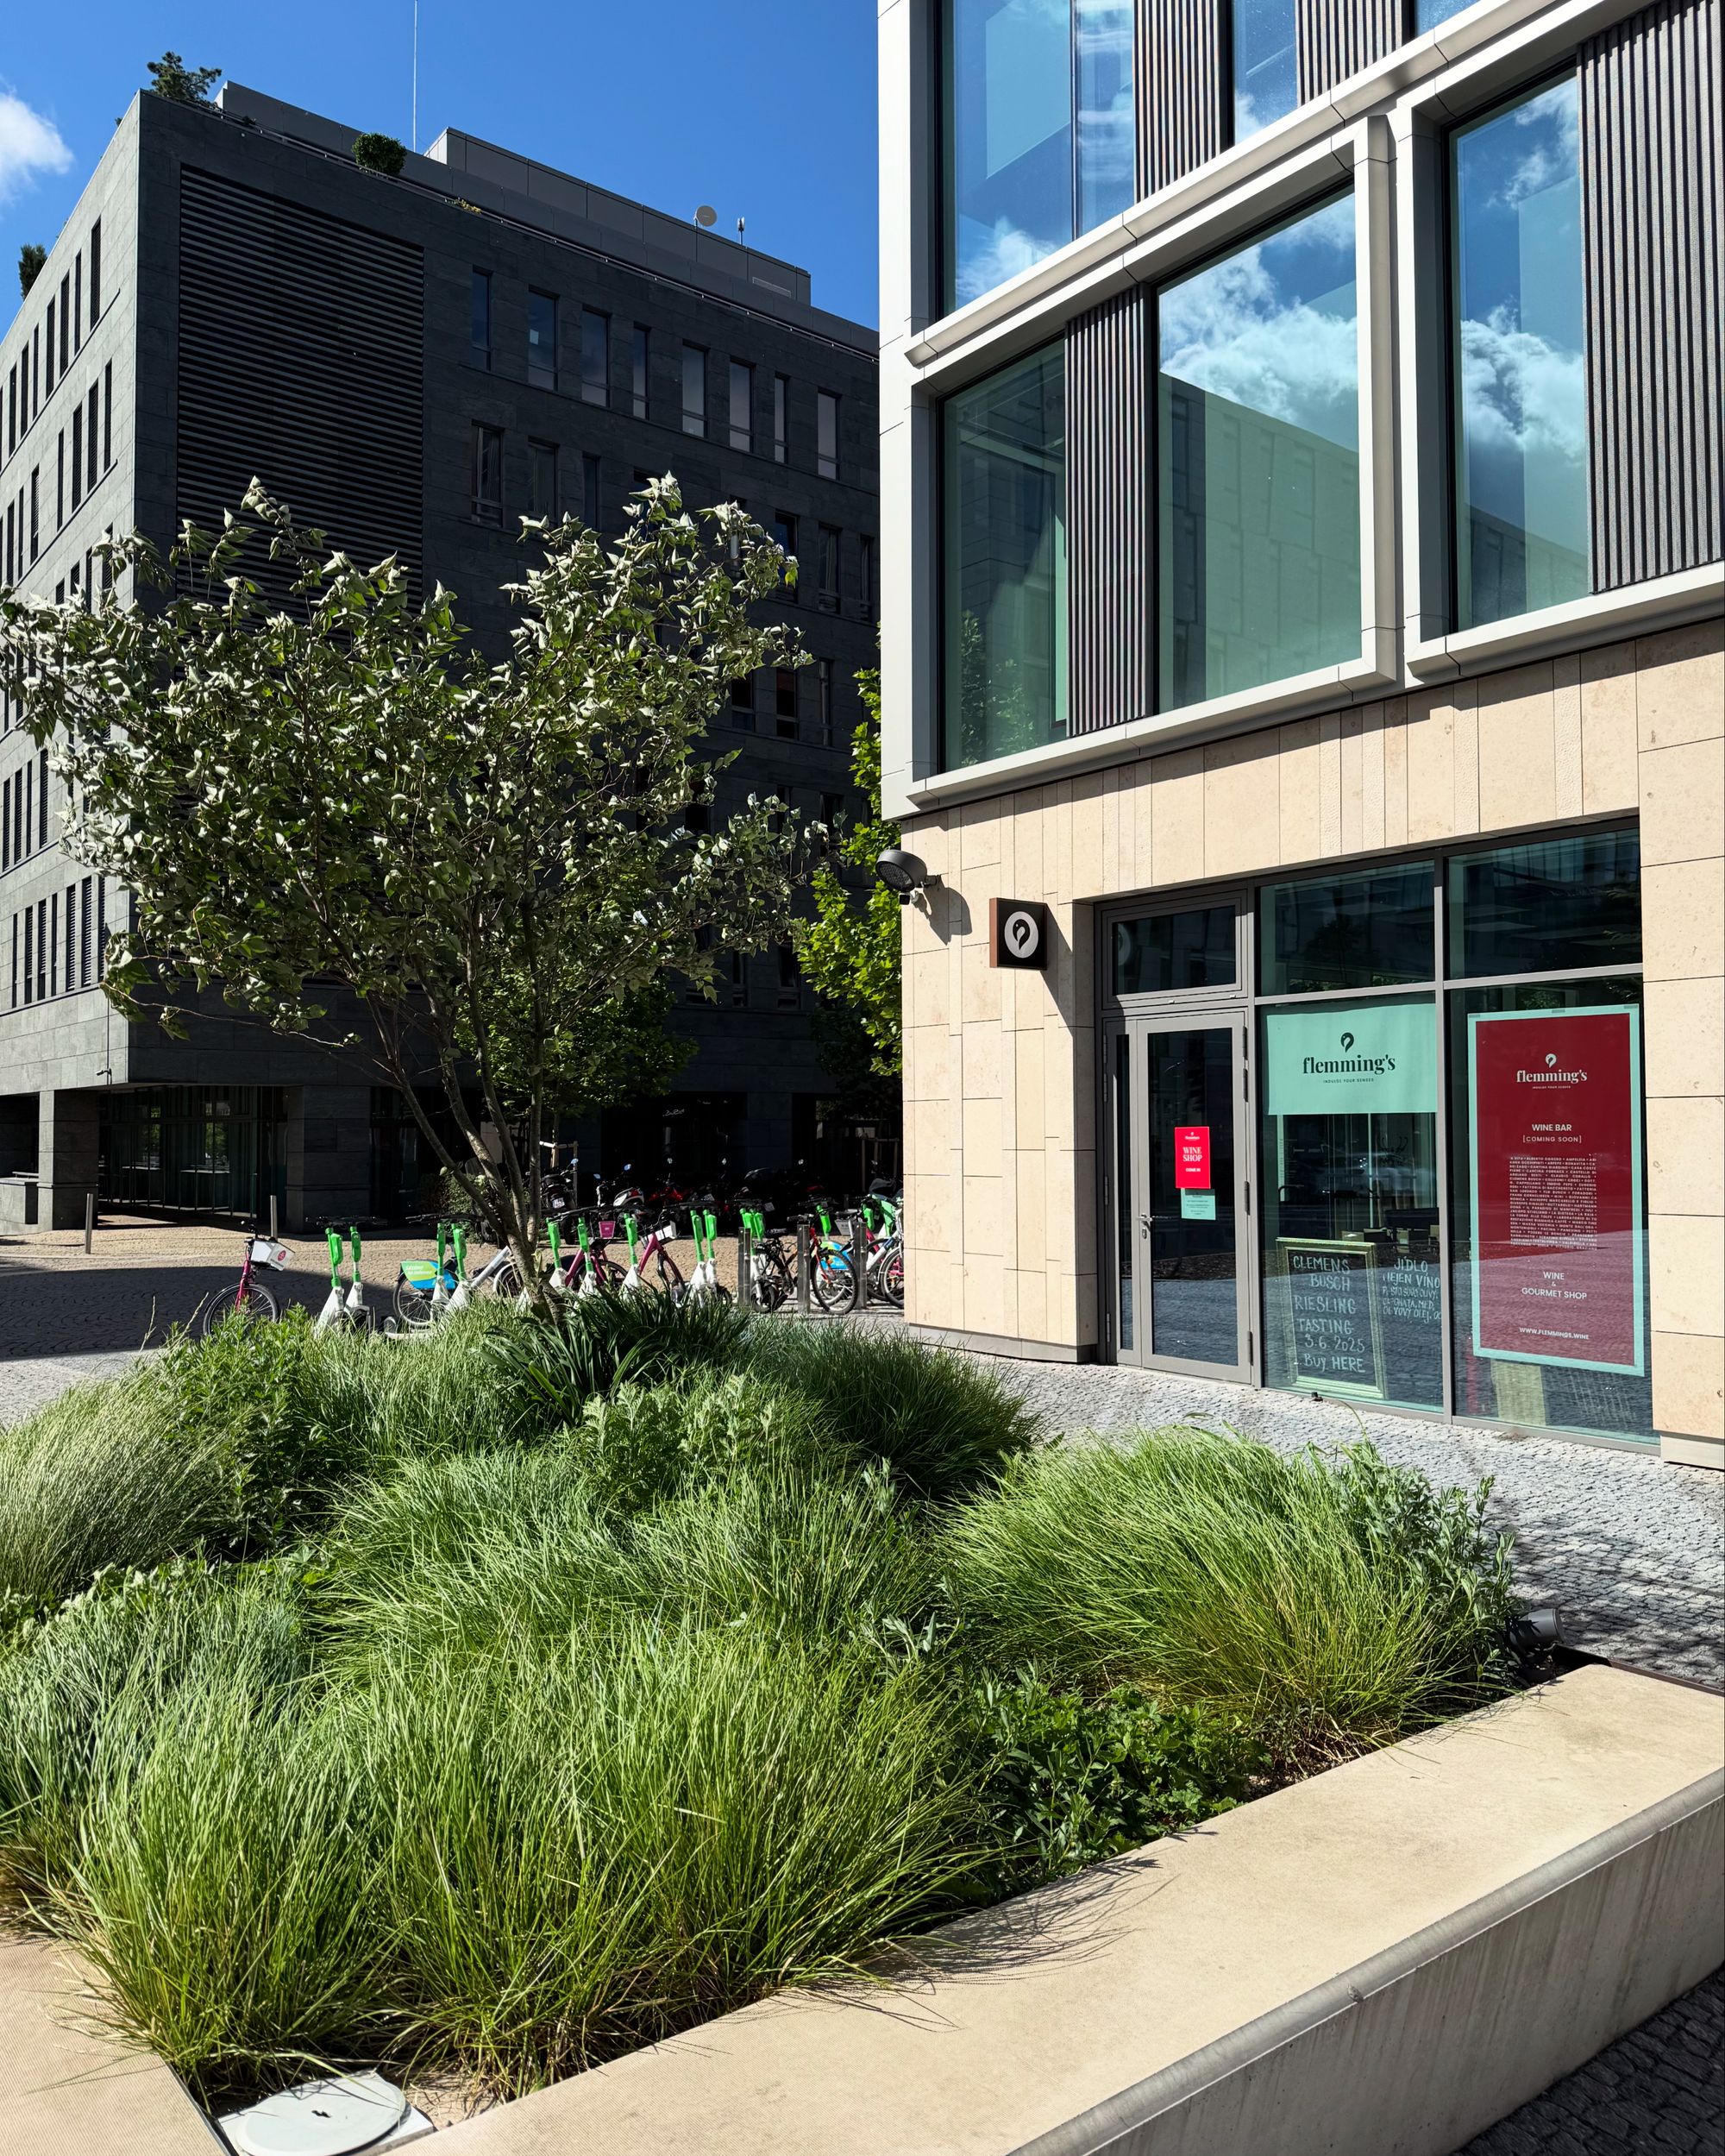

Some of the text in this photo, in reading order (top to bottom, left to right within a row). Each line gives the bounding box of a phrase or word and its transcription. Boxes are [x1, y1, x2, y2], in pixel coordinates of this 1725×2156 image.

[1303, 1054, 1395, 1075] flemming's
[1517, 1069, 1587, 1084] flemming's
[1558, 1135, 1582, 1143] SOON]
[1293, 1255, 1350, 1274] CLEMENS
[1394, 1256, 1428, 1272] JÍDLO
[1310, 1275, 1350, 1291] BUSCH
[1416, 1272, 1440, 1288] VÍNO
[1543, 1271, 1565, 1280] WINE
[1522, 1287, 1587, 1299] GOURMET SHOP
[1294, 1295, 1357, 1314] RIESLING
[1296, 1318, 1354, 1334] TASTING
[1519, 1328, 1589, 1339] WWW.FLEMMINGS.WINE
[1332, 1356, 1366, 1373] HERE
